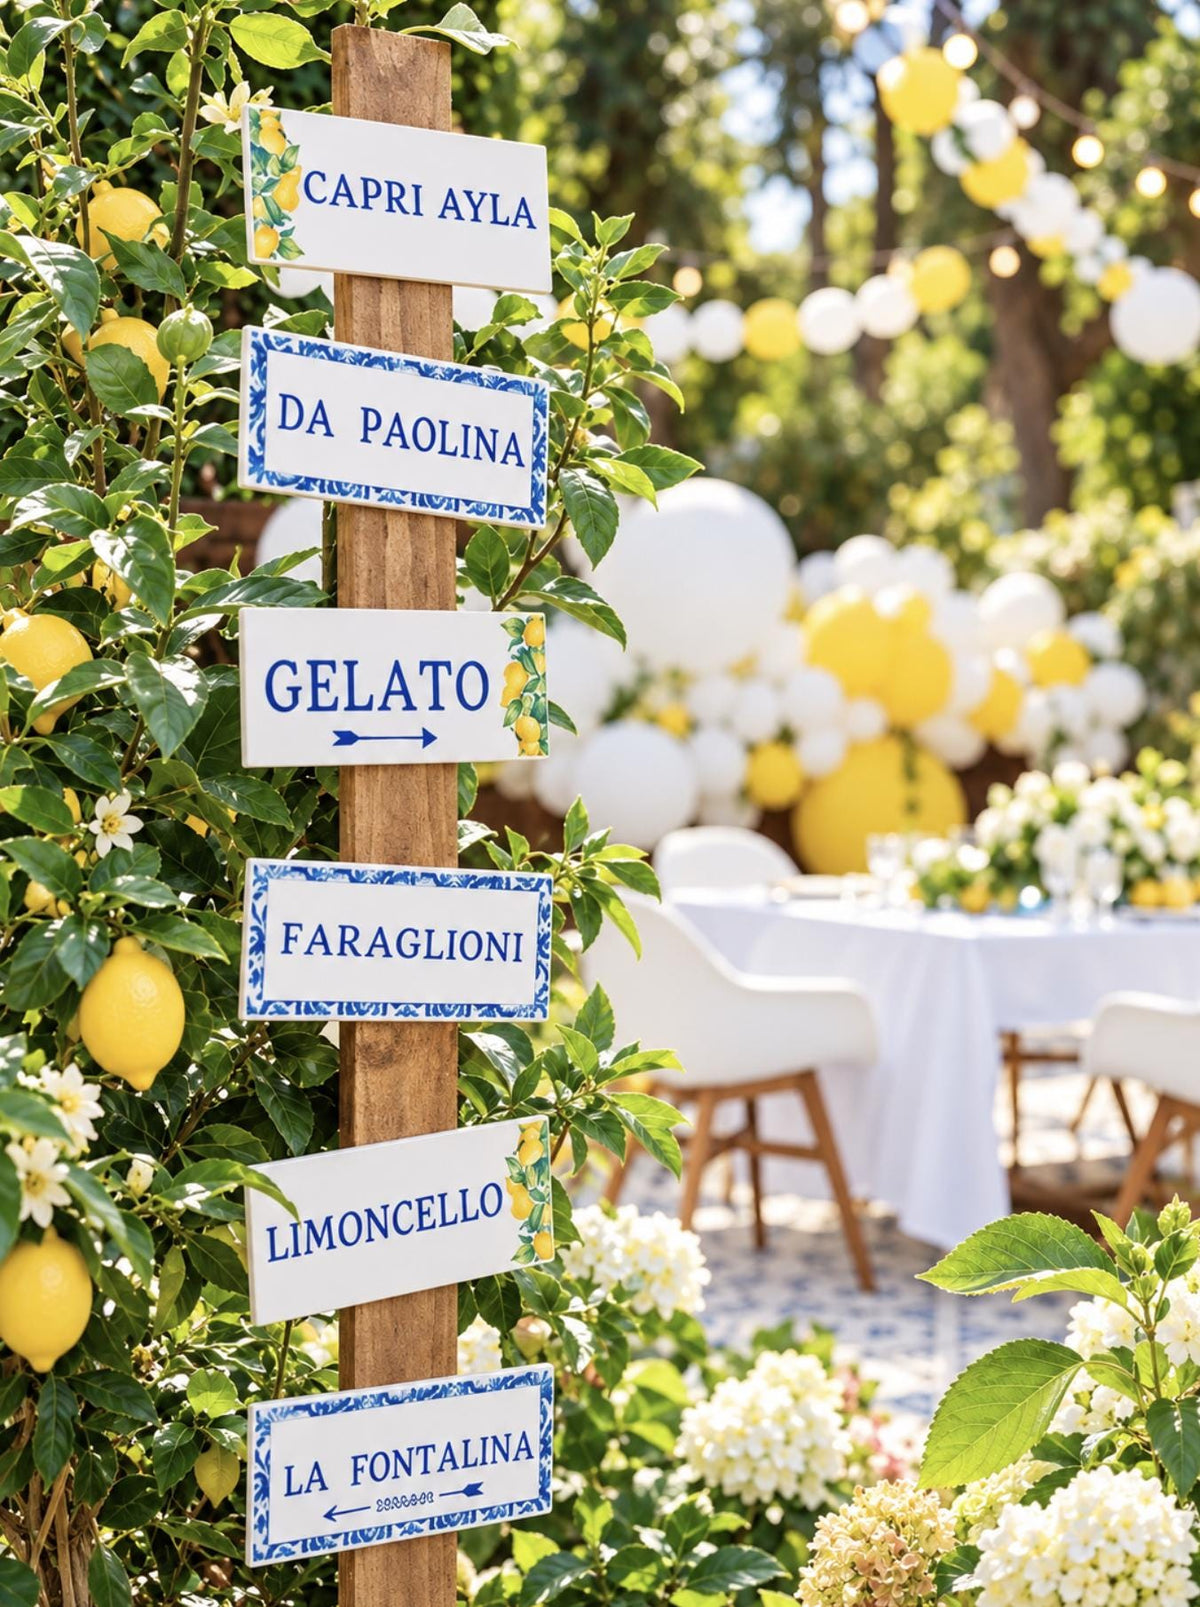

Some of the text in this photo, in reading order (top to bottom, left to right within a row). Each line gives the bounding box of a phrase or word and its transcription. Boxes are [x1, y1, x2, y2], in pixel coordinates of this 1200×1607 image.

[302, 170, 537, 231] CAPRI AYLA
[277, 392, 525, 469] DA PAOLINA
[264, 658, 490, 714] GELATO
[281, 921, 523, 963] FARAGLIONI
[266, 1181, 504, 1263] LIMONCELLO
[284, 1430, 534, 1498] LA FONTALINA
